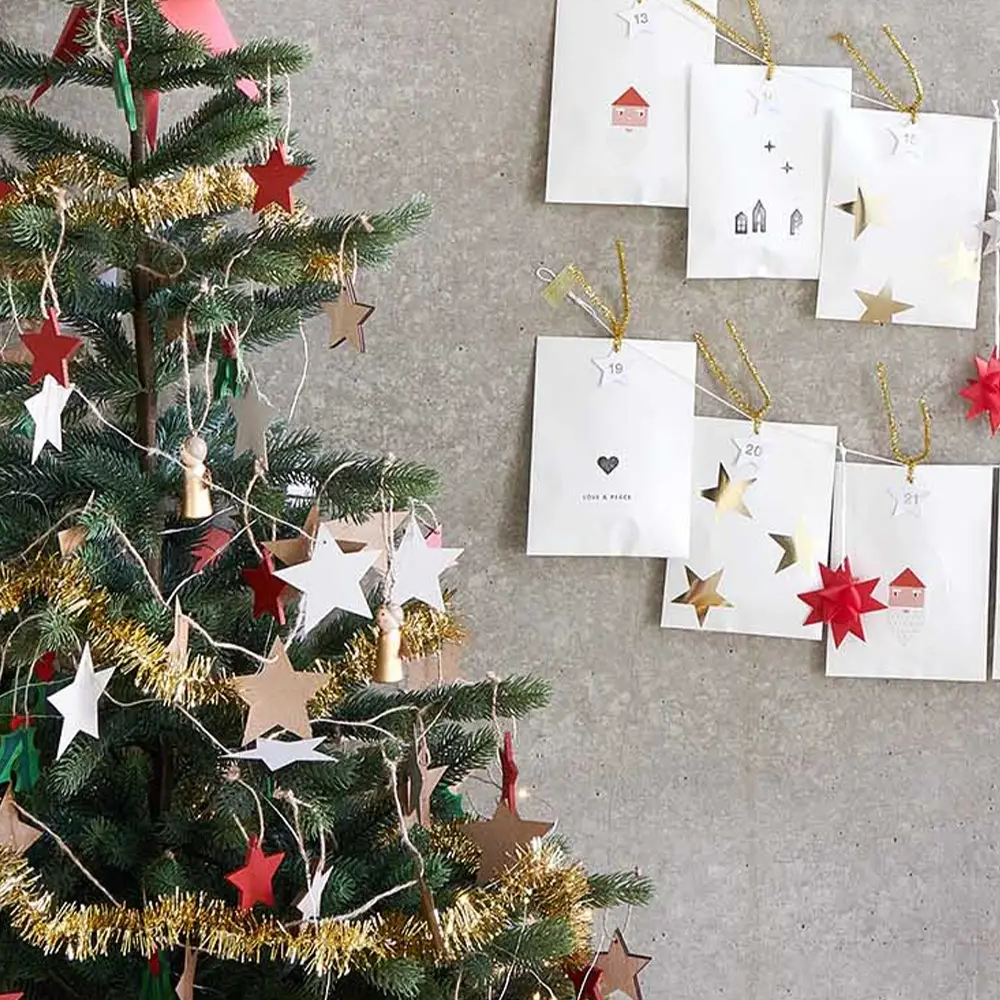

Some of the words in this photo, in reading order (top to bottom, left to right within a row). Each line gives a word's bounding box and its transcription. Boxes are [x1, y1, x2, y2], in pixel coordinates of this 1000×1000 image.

[633, 12, 649, 25] 13
[608, 362, 624, 375] 19
[744, 444, 762, 457] 20
[903, 493, 920, 505] 21
